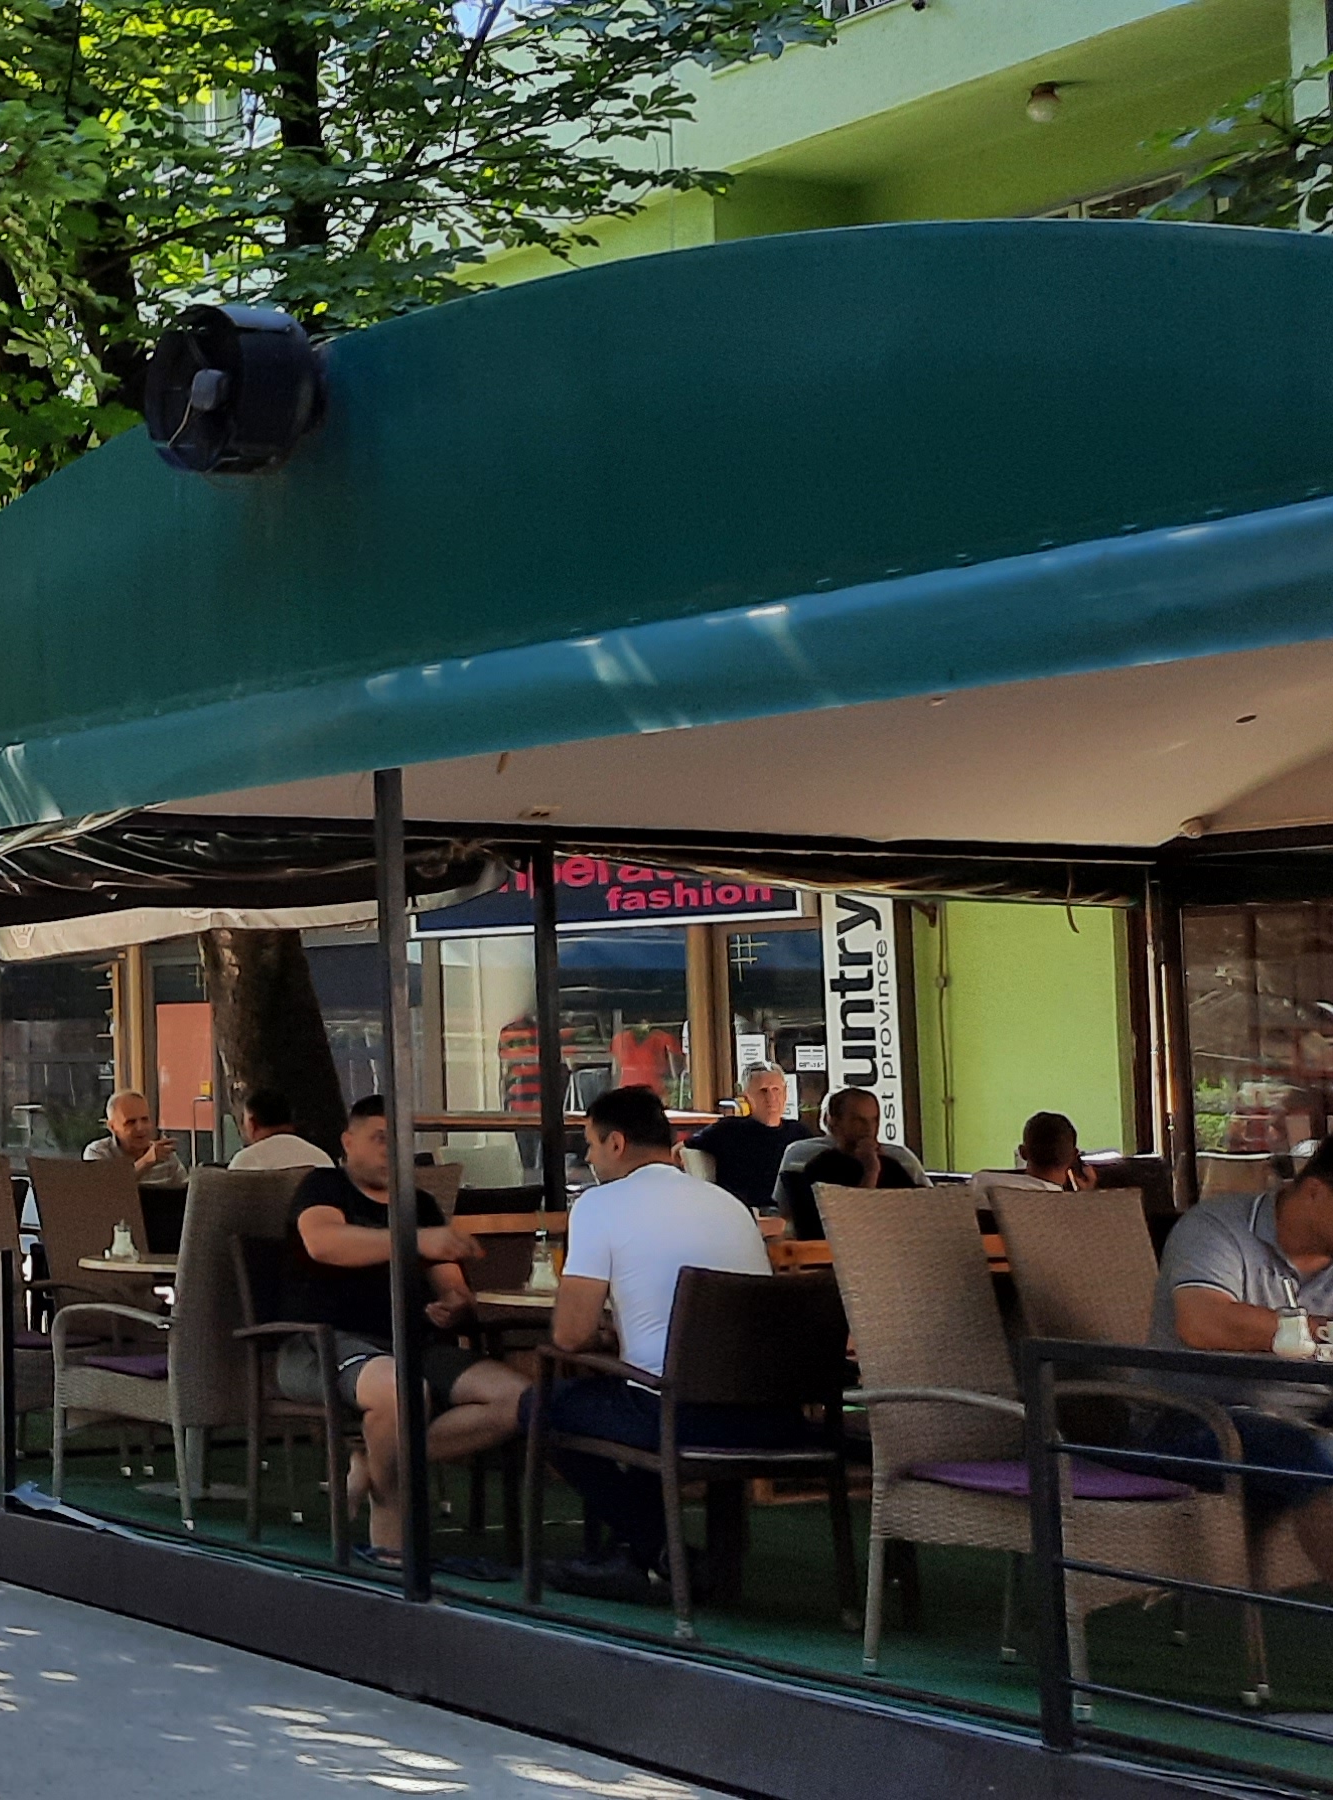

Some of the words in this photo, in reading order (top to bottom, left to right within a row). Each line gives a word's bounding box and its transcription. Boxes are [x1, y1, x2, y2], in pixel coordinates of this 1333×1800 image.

[605, 880, 773, 911] fashion
[829, 894, 882, 1087] untry
[876, 939, 898, 1080] province
[882, 1091, 897, 1141] est
